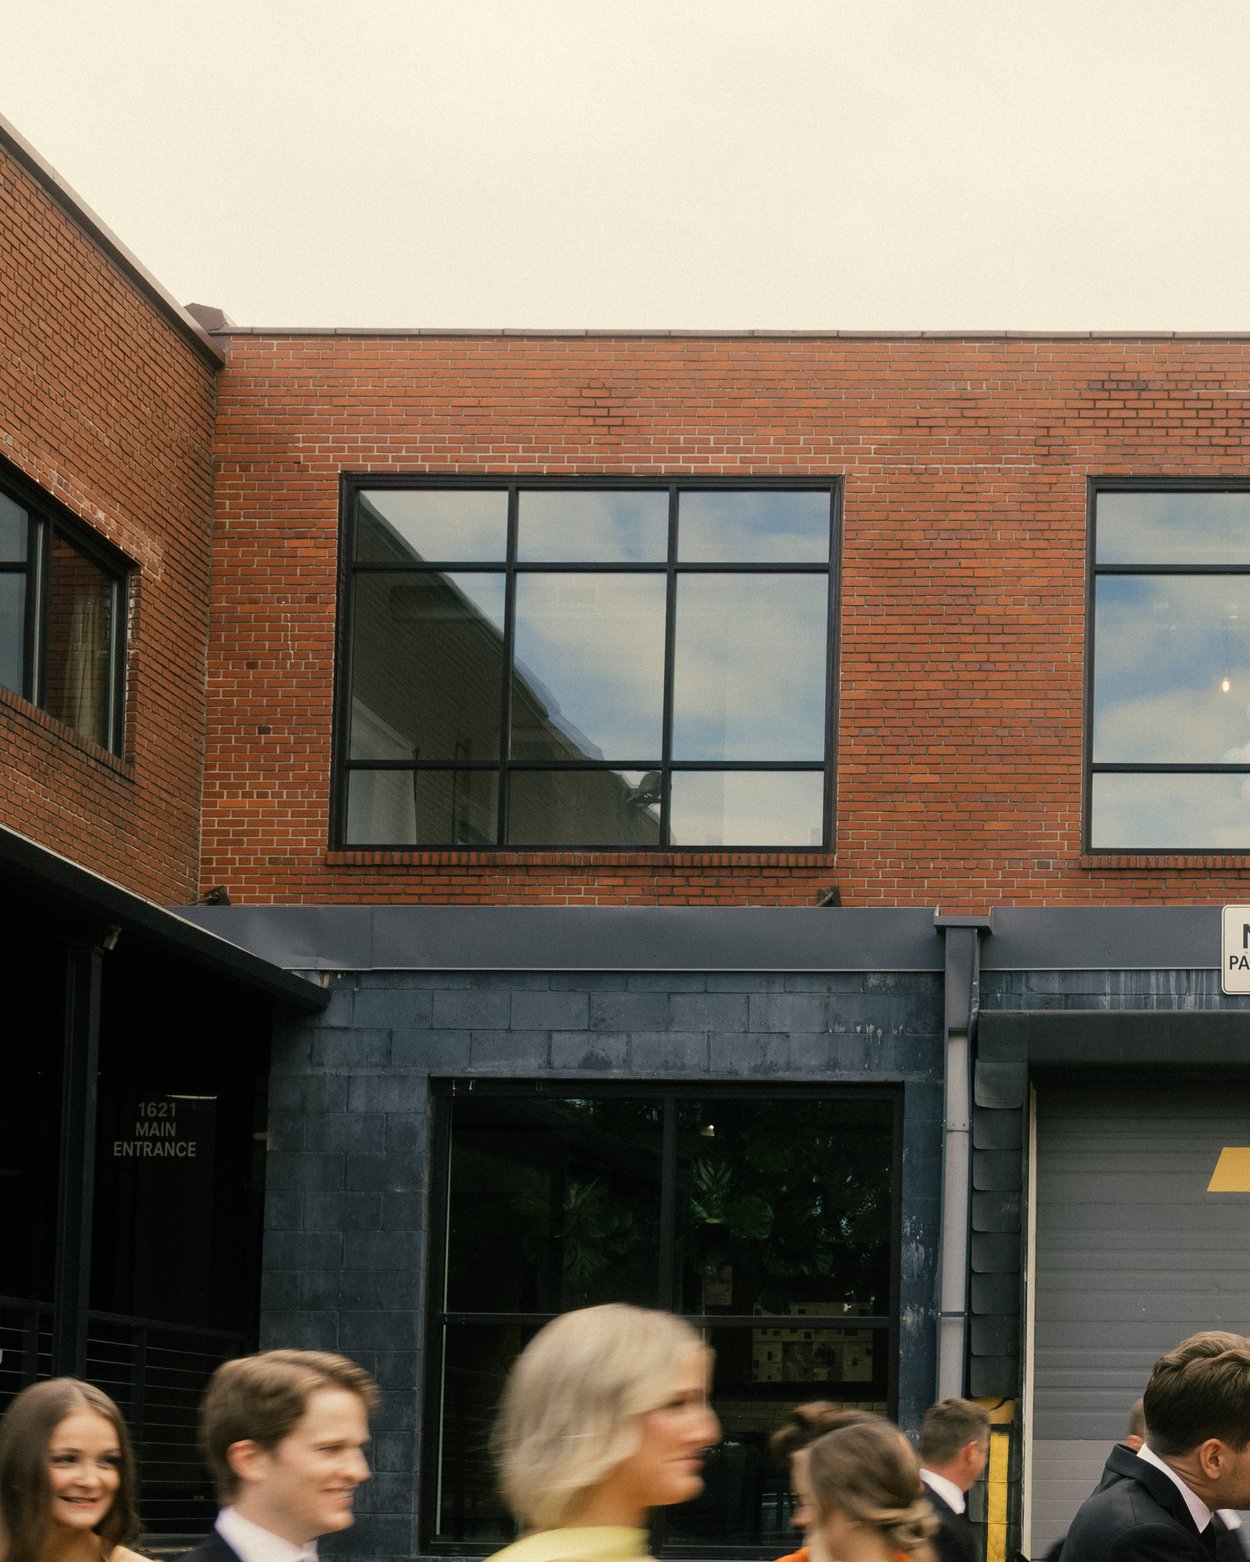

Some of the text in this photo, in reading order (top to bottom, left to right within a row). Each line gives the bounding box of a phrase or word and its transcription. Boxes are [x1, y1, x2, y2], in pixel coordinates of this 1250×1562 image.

[138, 1102, 176, 1117] 1621
[135, 1121, 176, 1137] MAIN
[113, 1141, 196, 1157] ENTRANCE
